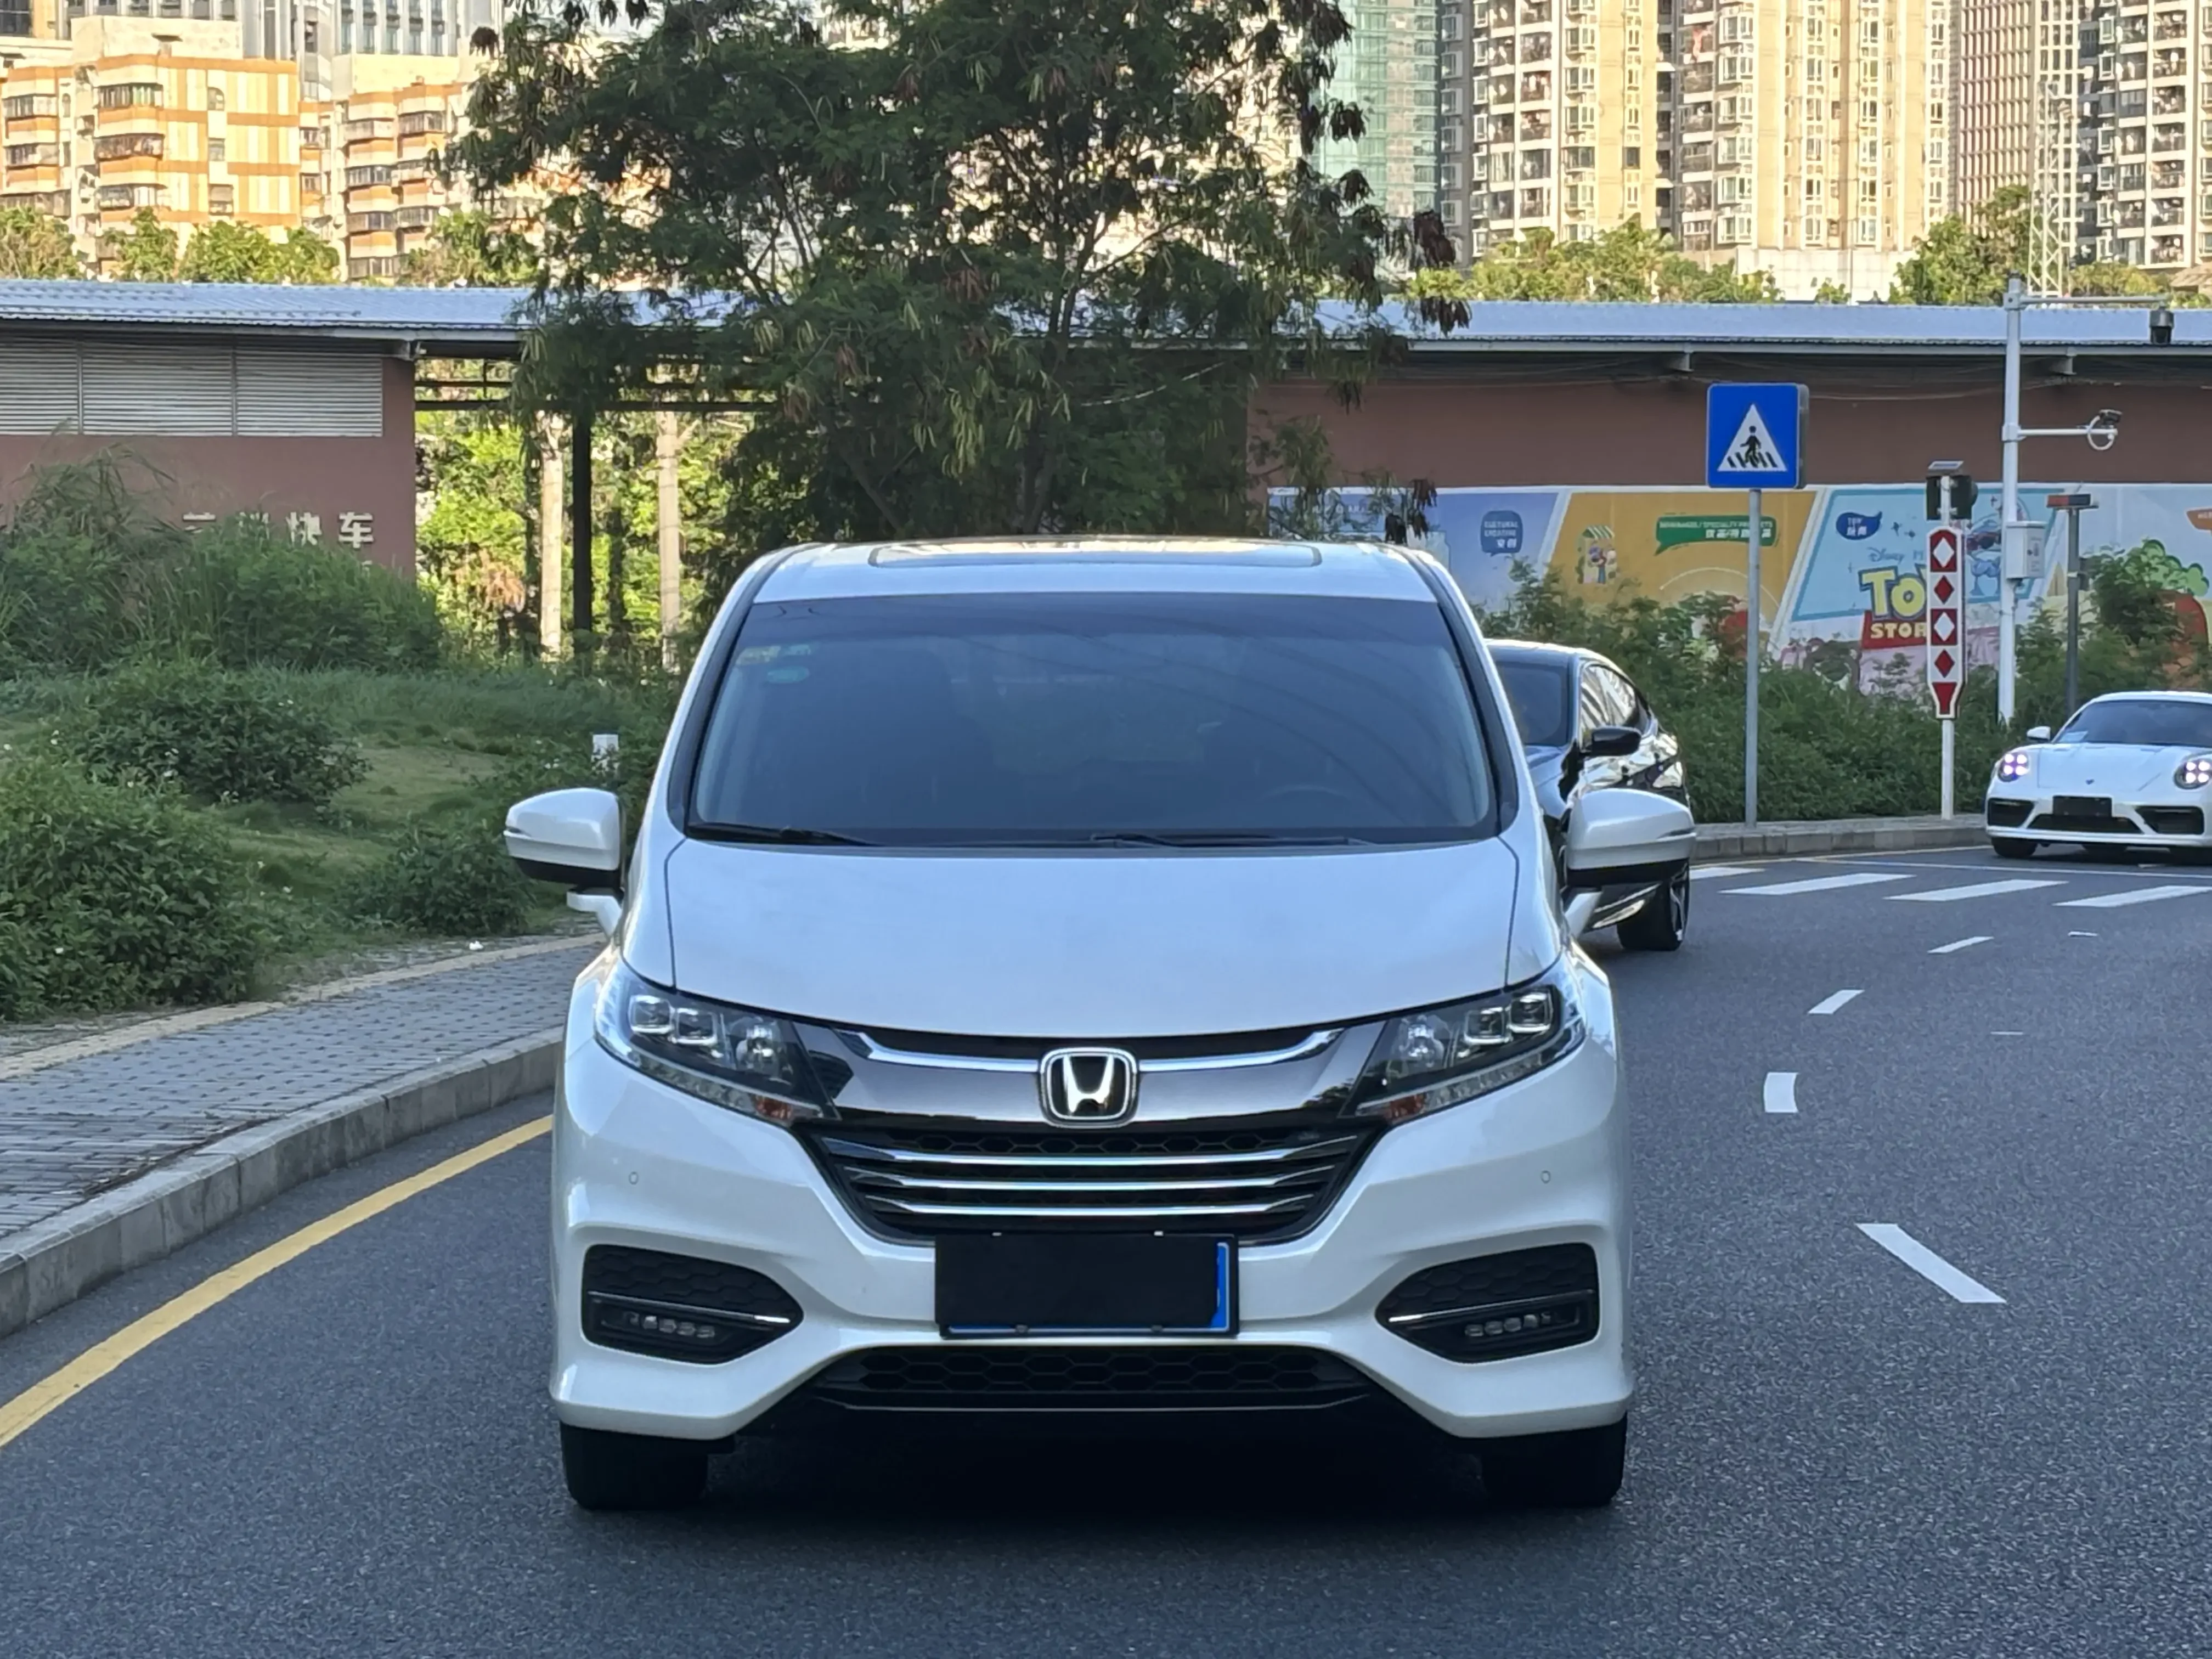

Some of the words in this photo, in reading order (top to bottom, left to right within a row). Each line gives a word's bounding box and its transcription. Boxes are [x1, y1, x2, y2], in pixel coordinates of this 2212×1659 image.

[183, 512, 374, 548] 快车
[1859, 563, 1927, 620] TO
[1870, 622, 1927, 639] STOR
